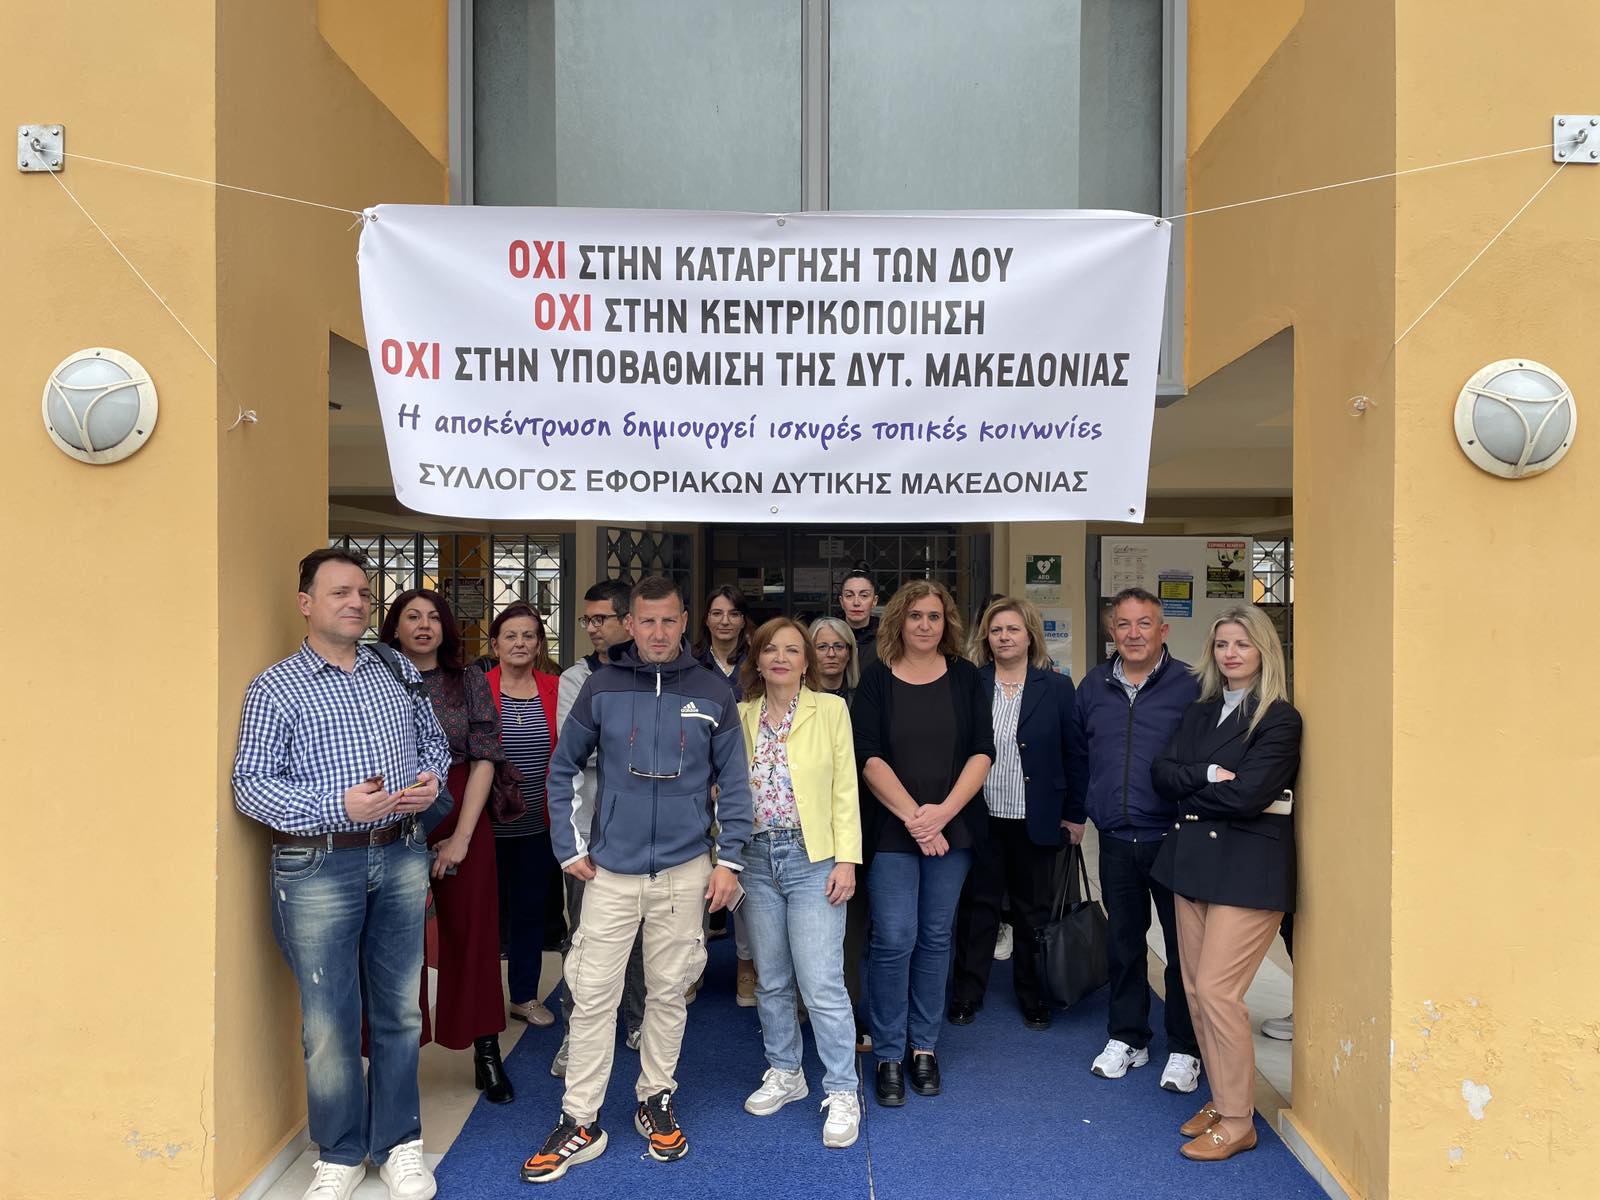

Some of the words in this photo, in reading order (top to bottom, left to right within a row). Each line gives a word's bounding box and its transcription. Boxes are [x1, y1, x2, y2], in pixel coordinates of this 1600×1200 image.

[508, 239, 566, 280] ΟΧΙ
[578, 244, 662, 281] ΣΤΗΝ
[675, 246, 861, 283] ΚΑΤΑΡΓΗΣΗ
[872, 247, 937, 283] ΤΩΝ
[948, 247, 1014, 283] ΔΟΥ
[534, 292, 591, 332] ΟΧΙ
[604, 297, 687, 334] ΣΤΗΝ
[700, 299, 985, 335] ΚΕΝΤΡΙΚΟΠΟΙΗΣΗ
[381, 338, 440, 380] ΟΧΙ
[454, 346, 538, 382] ΣΤΗΝ
[550, 348, 764, 386] ΥΠΟΒΑΘΜΙΣΗ
[775, 352, 836, 387] ΤΗΣ
[846, 352, 913, 388] ΔΥΤ.
[925, 352, 1130, 388] ΜΑΚΕΔΟΝΙΑΣ
[398, 403, 421, 430] Η
[434, 410, 612, 447] αποκέντρωση
[623, 411, 757, 450] δημιουργεί
[770, 414, 862, 451] ισχυρές
[871, 414, 968, 443] τοπικές
[979, 414, 1103, 443] κοινωνίες
[419, 462, 577, 491] ΣΥΛΛΟΓΟΣ
[586, 469, 763, 494] ΕΦΟΡΙΑΚΩΝ
[771, 472, 892, 495] ΔΥΤΙΚΗΣ
[901, 470, 1089, 495] ΜΑΚΕΔΟΝΙΑΣ
